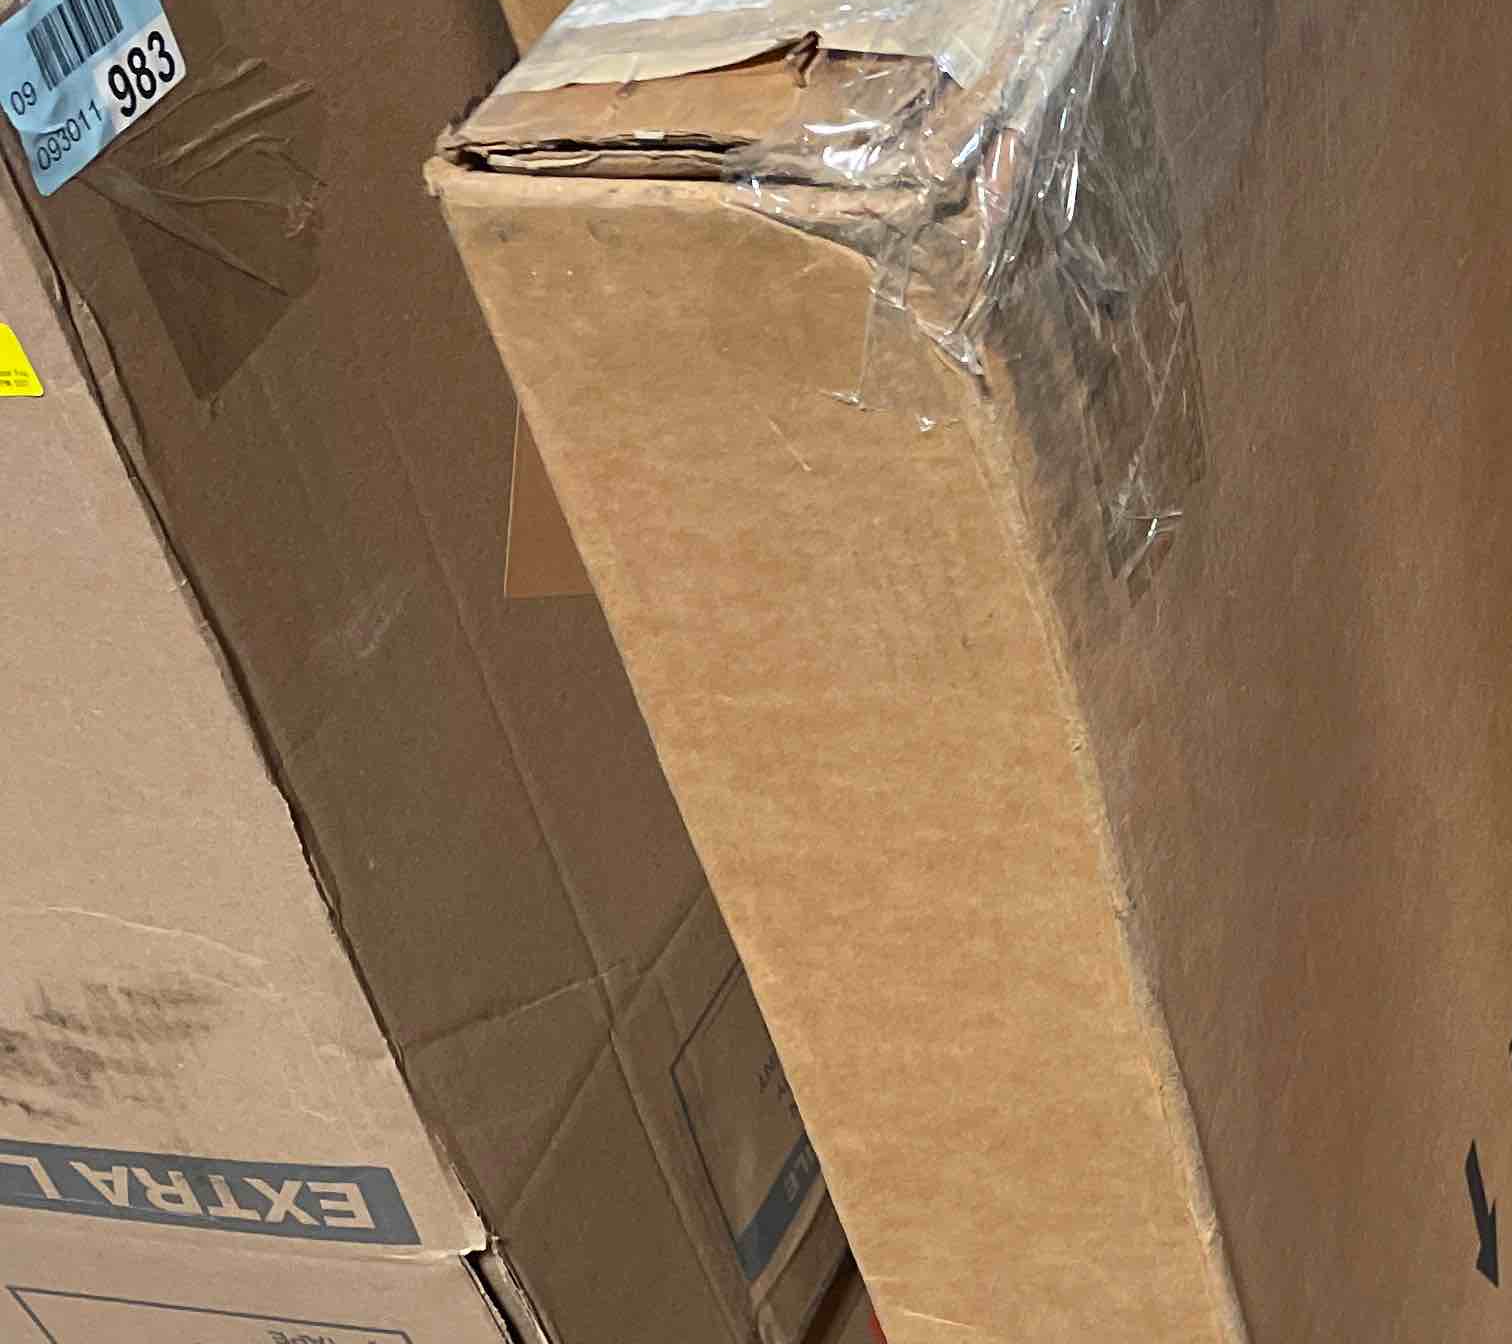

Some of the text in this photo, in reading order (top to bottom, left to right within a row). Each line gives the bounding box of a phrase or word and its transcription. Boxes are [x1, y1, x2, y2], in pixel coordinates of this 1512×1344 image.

[10, 80, 38, 116] 09
[107, 30, 176, 118] 983
[36, 98, 104, 171] 093011
[69, 1160, 376, 1230] EXTRA
